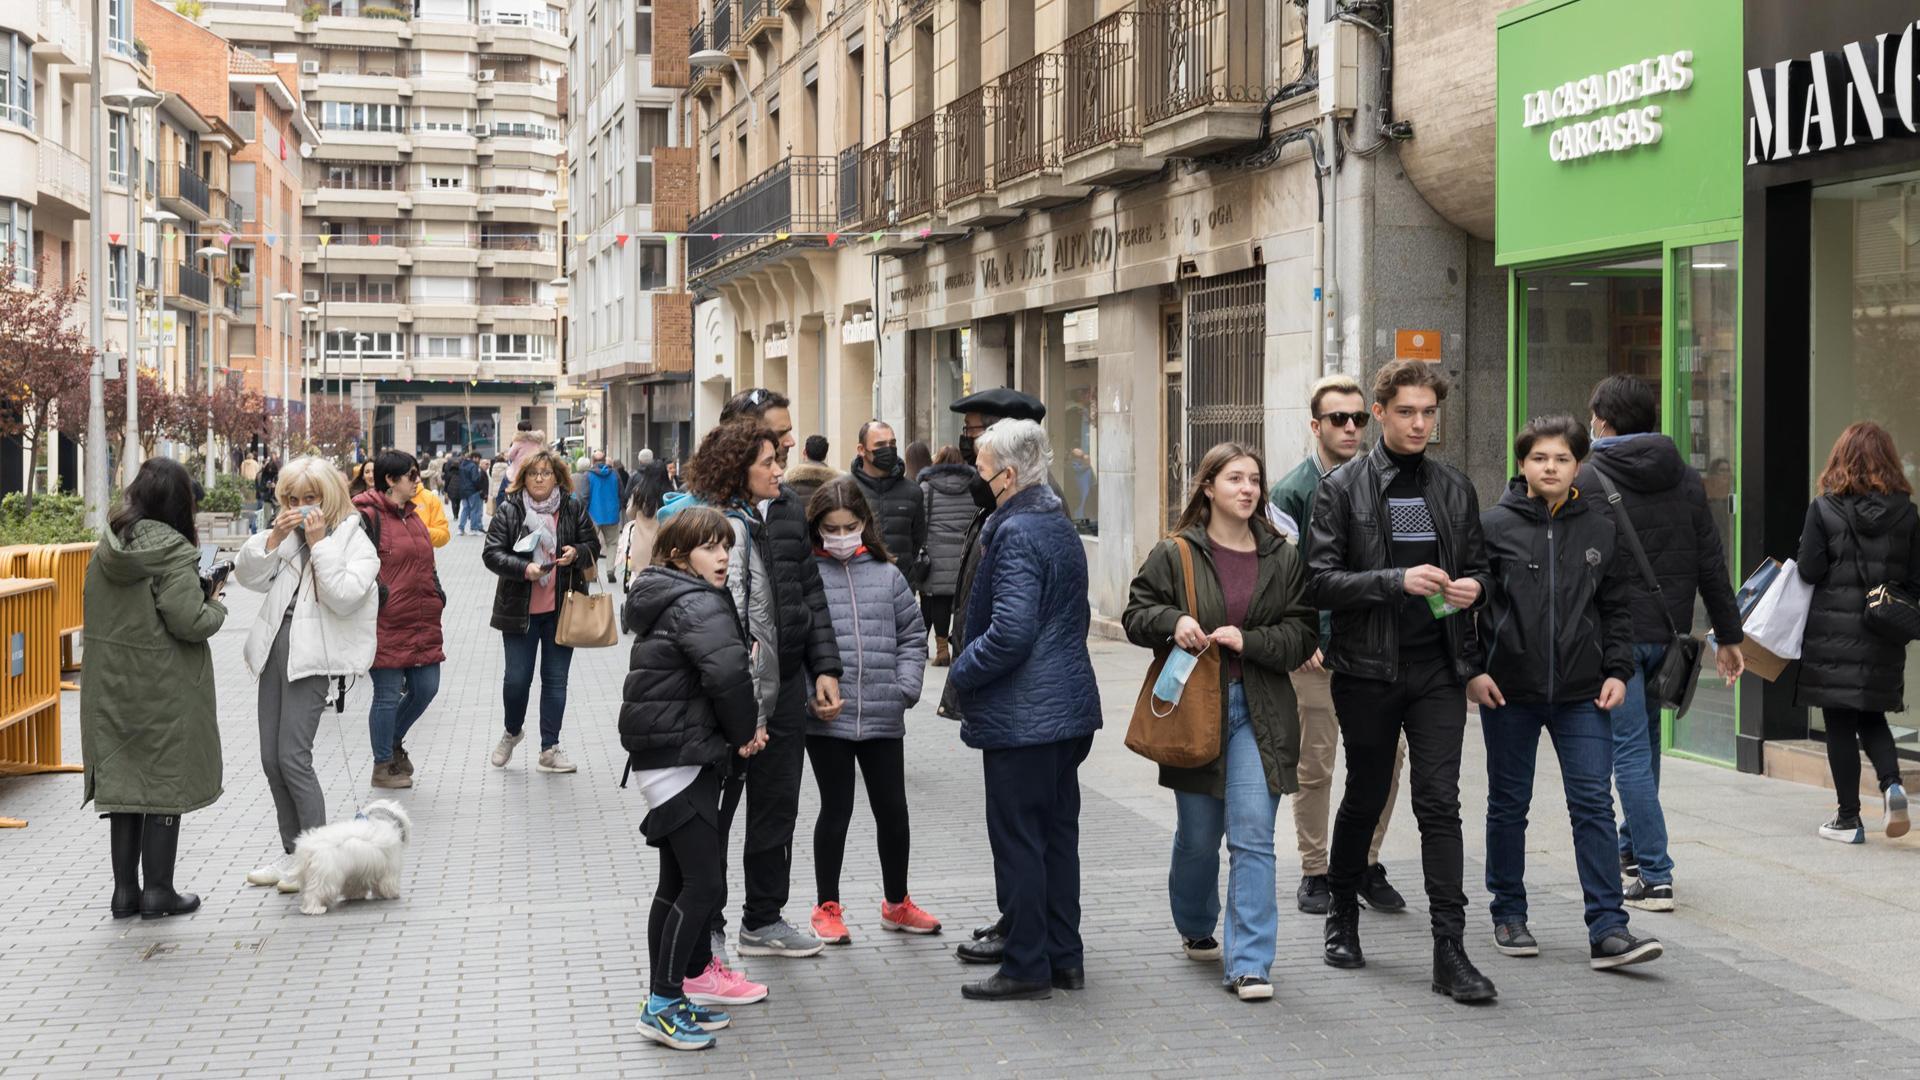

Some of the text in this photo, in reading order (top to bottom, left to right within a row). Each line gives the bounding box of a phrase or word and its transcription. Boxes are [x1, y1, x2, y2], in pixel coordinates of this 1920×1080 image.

[1522, 50, 1694, 128] LA CASA DE LAS
[1549, 104, 1663, 162] CARCASAS
[1053, 226, 1113, 275] ALFONSO
